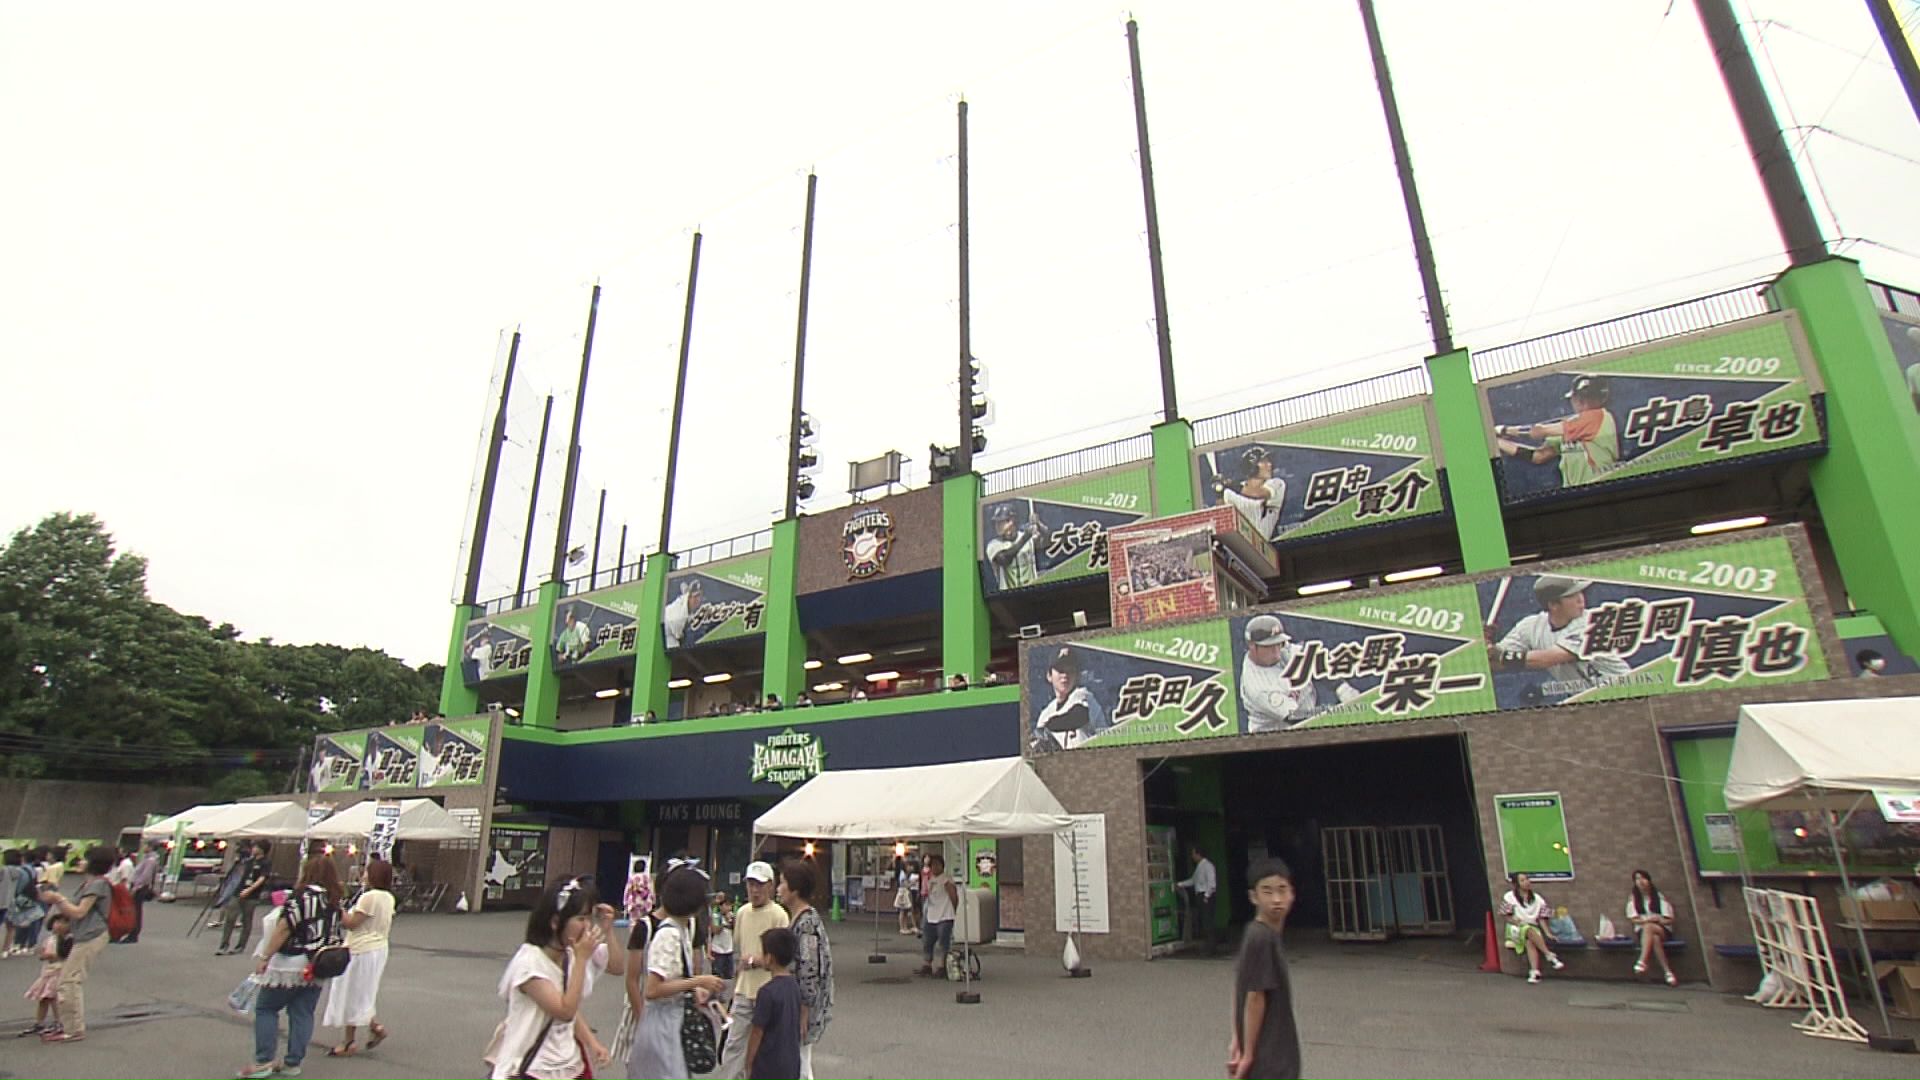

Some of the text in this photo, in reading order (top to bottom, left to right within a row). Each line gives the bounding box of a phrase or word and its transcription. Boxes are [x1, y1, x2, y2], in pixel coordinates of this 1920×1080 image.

[1713, 357, 1781, 376] 2009
[1626, 395, 1806, 454] 中島卓也
[1369, 433, 1417, 451] 2000
[1103, 492, 1138, 509] 2013
[1305, 464, 1433, 519] 田中賢介
[842, 512, 890, 537] FIGHTERS
[1639, 561, 1777, 593] SINCE 2003
[690, 600, 766, 631] ダルビッシュ有
[1359, 604, 1465, 632] SINCE 2003
[596, 623, 638, 651] 中田翔
[1134, 637, 1220, 664] SINCE 2003
[1579, 597, 1809, 686] 鶴岡慎也
[1281, 633, 1485, 714] 小谷野栄一
[1112, 673, 1229, 734] 武田久
[768, 733, 810, 747] FIGHTERS
[753, 740, 820, 779] KAMAGAYA
[768, 769, 806, 782] STADIUM
[659, 803, 741, 820] FAN'S LOUNGE
